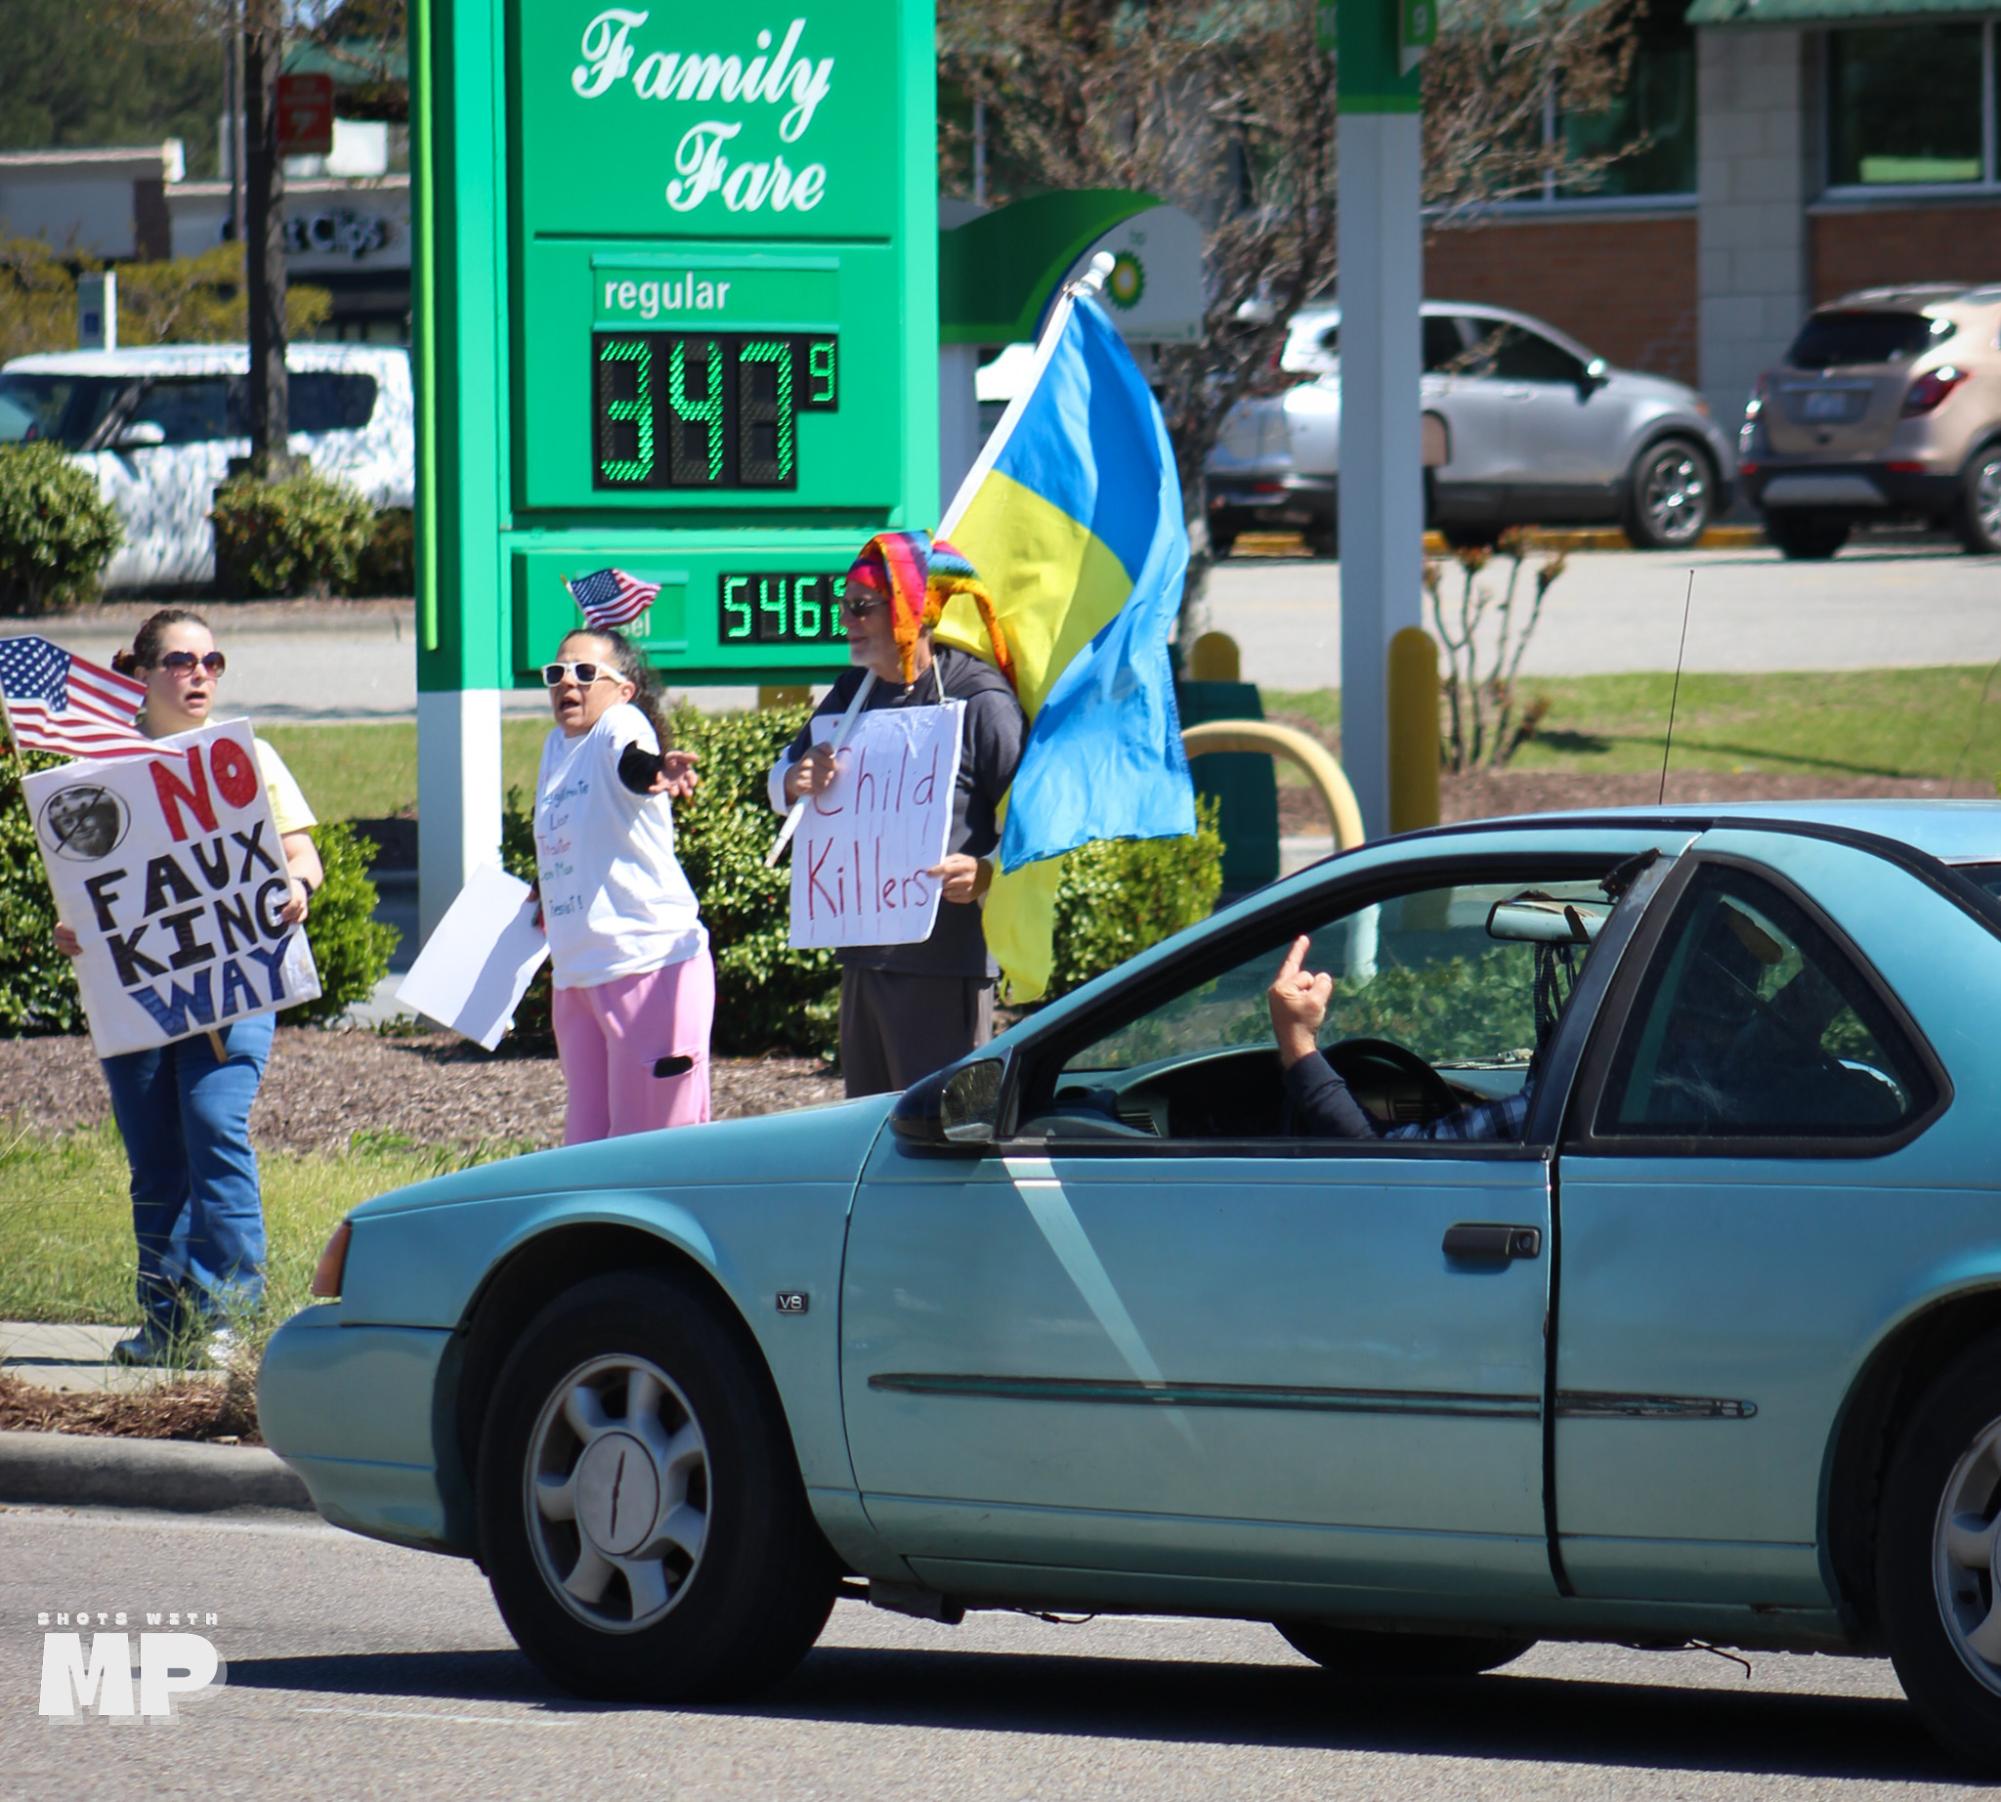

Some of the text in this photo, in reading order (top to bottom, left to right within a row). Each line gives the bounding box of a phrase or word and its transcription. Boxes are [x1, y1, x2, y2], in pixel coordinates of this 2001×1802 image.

[571, 8, 834, 143] Family
[665, 121, 826, 212] Fare
[604, 271, 731, 319] regular
[149, 738, 258, 842] NO
[85, 820, 279, 931] FAUX
[808, 836, 930, 920] Killers
[106, 878, 290, 987] KING
[129, 934, 293, 1037] WAY
[779, 1295, 802, 1309] V8
